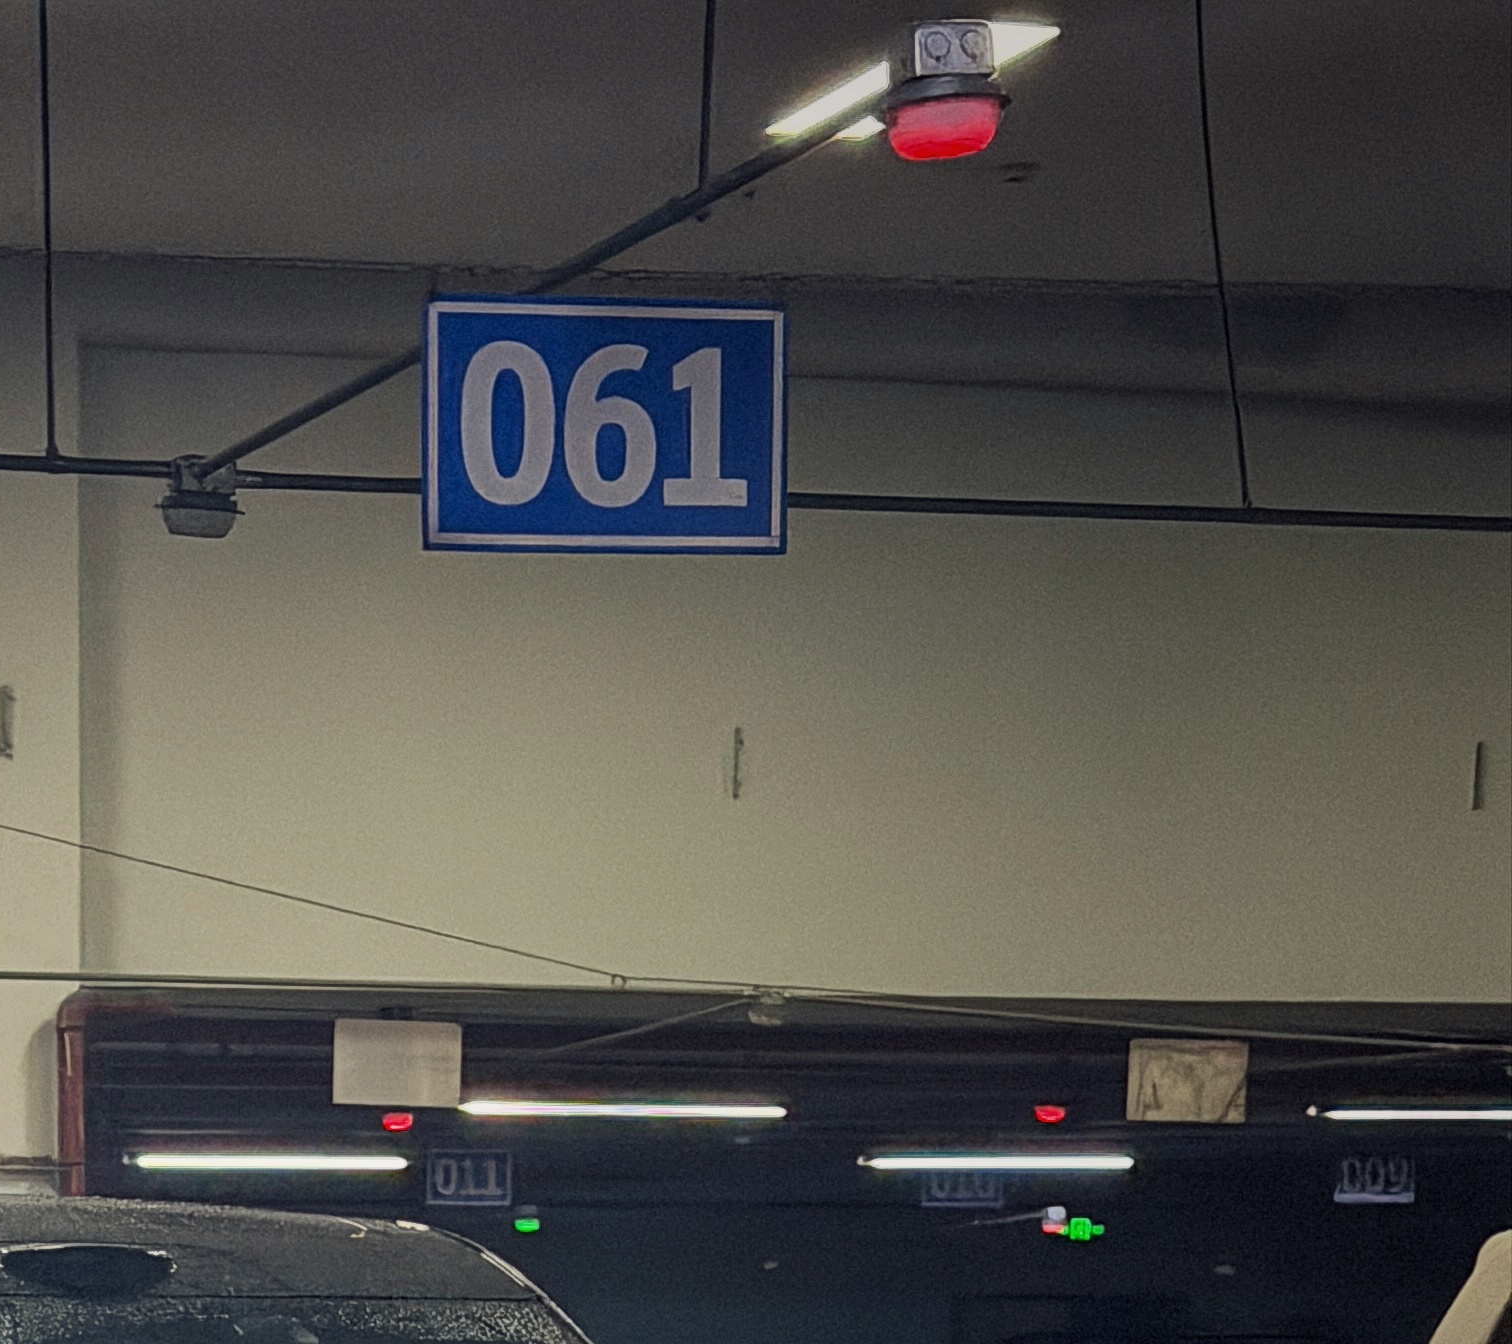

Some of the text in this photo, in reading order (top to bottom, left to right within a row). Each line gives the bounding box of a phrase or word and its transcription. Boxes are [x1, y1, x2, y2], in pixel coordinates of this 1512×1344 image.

[460, 339, 749, 508] 061
[435, 1157, 504, 1196] 011
[1341, 1157, 1409, 1193] 009
